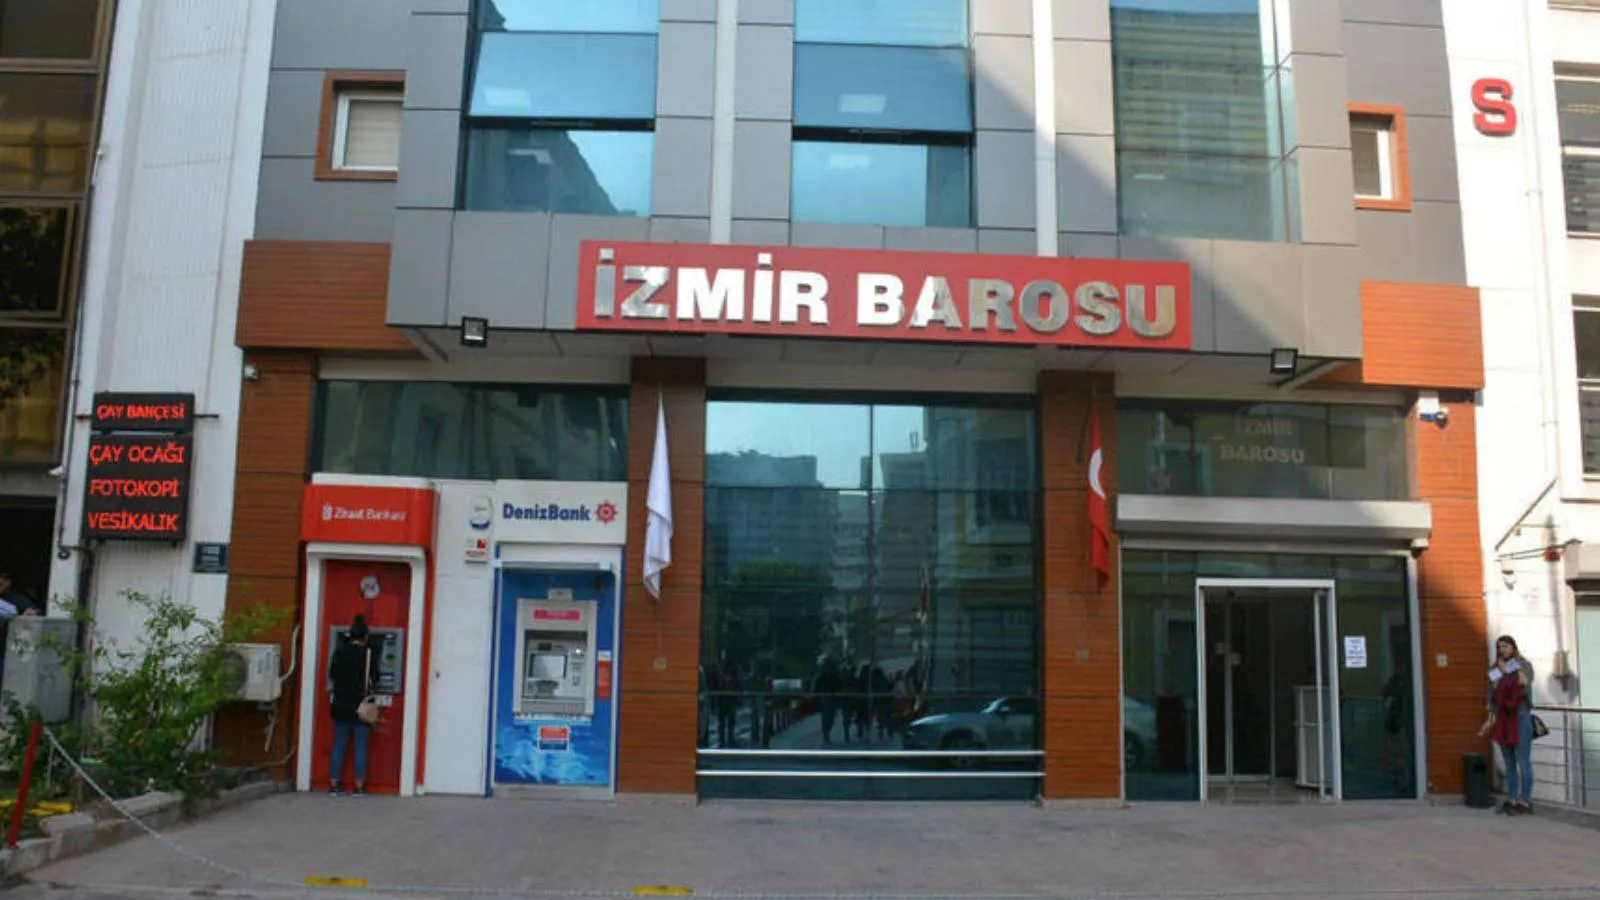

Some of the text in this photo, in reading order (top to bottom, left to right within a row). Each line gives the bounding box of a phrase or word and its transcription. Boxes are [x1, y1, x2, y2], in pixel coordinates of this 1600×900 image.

[1471, 78, 1518, 137] S
[594, 248, 1177, 339] İZMİR BAROSU
[127, 403, 186, 421] BAHÇESİ
[90, 442, 186, 465] ÇAY OCAĞI
[1220, 444, 1306, 464] BAROSU
[89, 479, 179, 497] FOTOKOPİ
[88, 511, 178, 531] VESİKALIK
[502, 503, 591, 522] DenizBank
